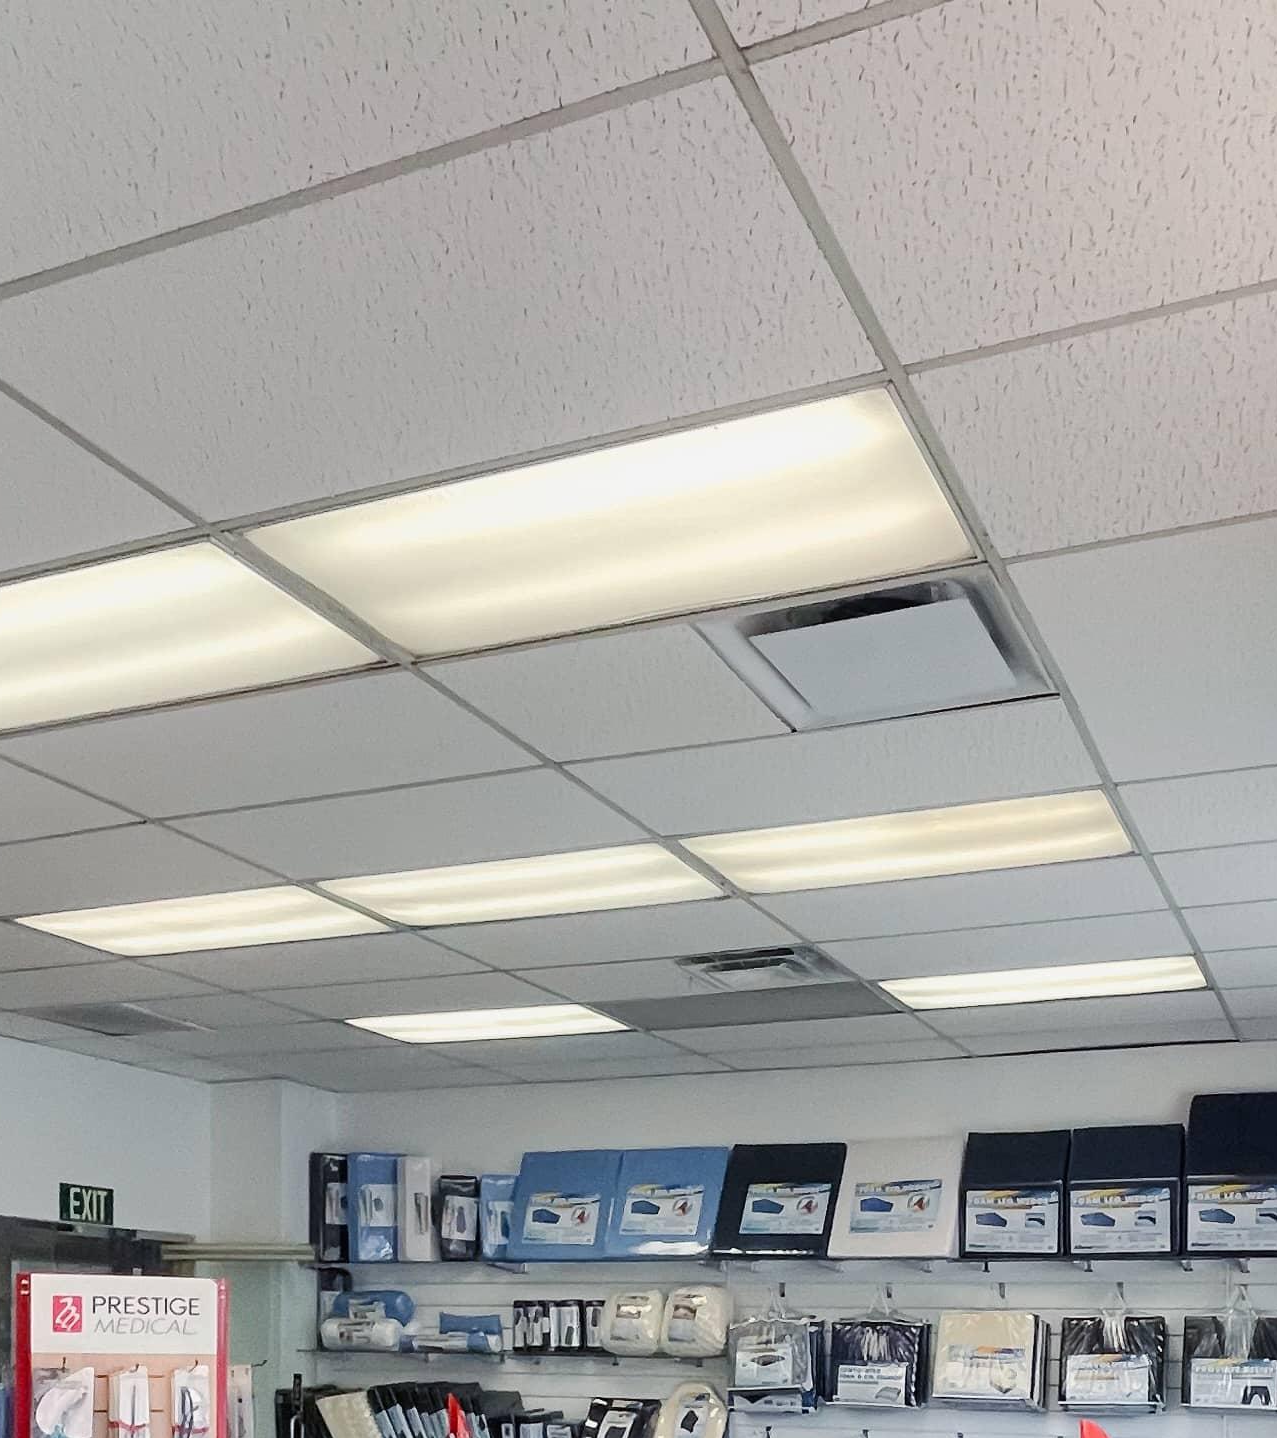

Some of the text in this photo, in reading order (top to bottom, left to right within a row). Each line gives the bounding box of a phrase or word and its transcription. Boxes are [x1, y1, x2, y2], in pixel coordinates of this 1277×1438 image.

[69, 1187, 108, 1222] EXIT
[92, 1295, 200, 1316] PRESTIGE
[93, 1316, 199, 1336] MEDICAL
